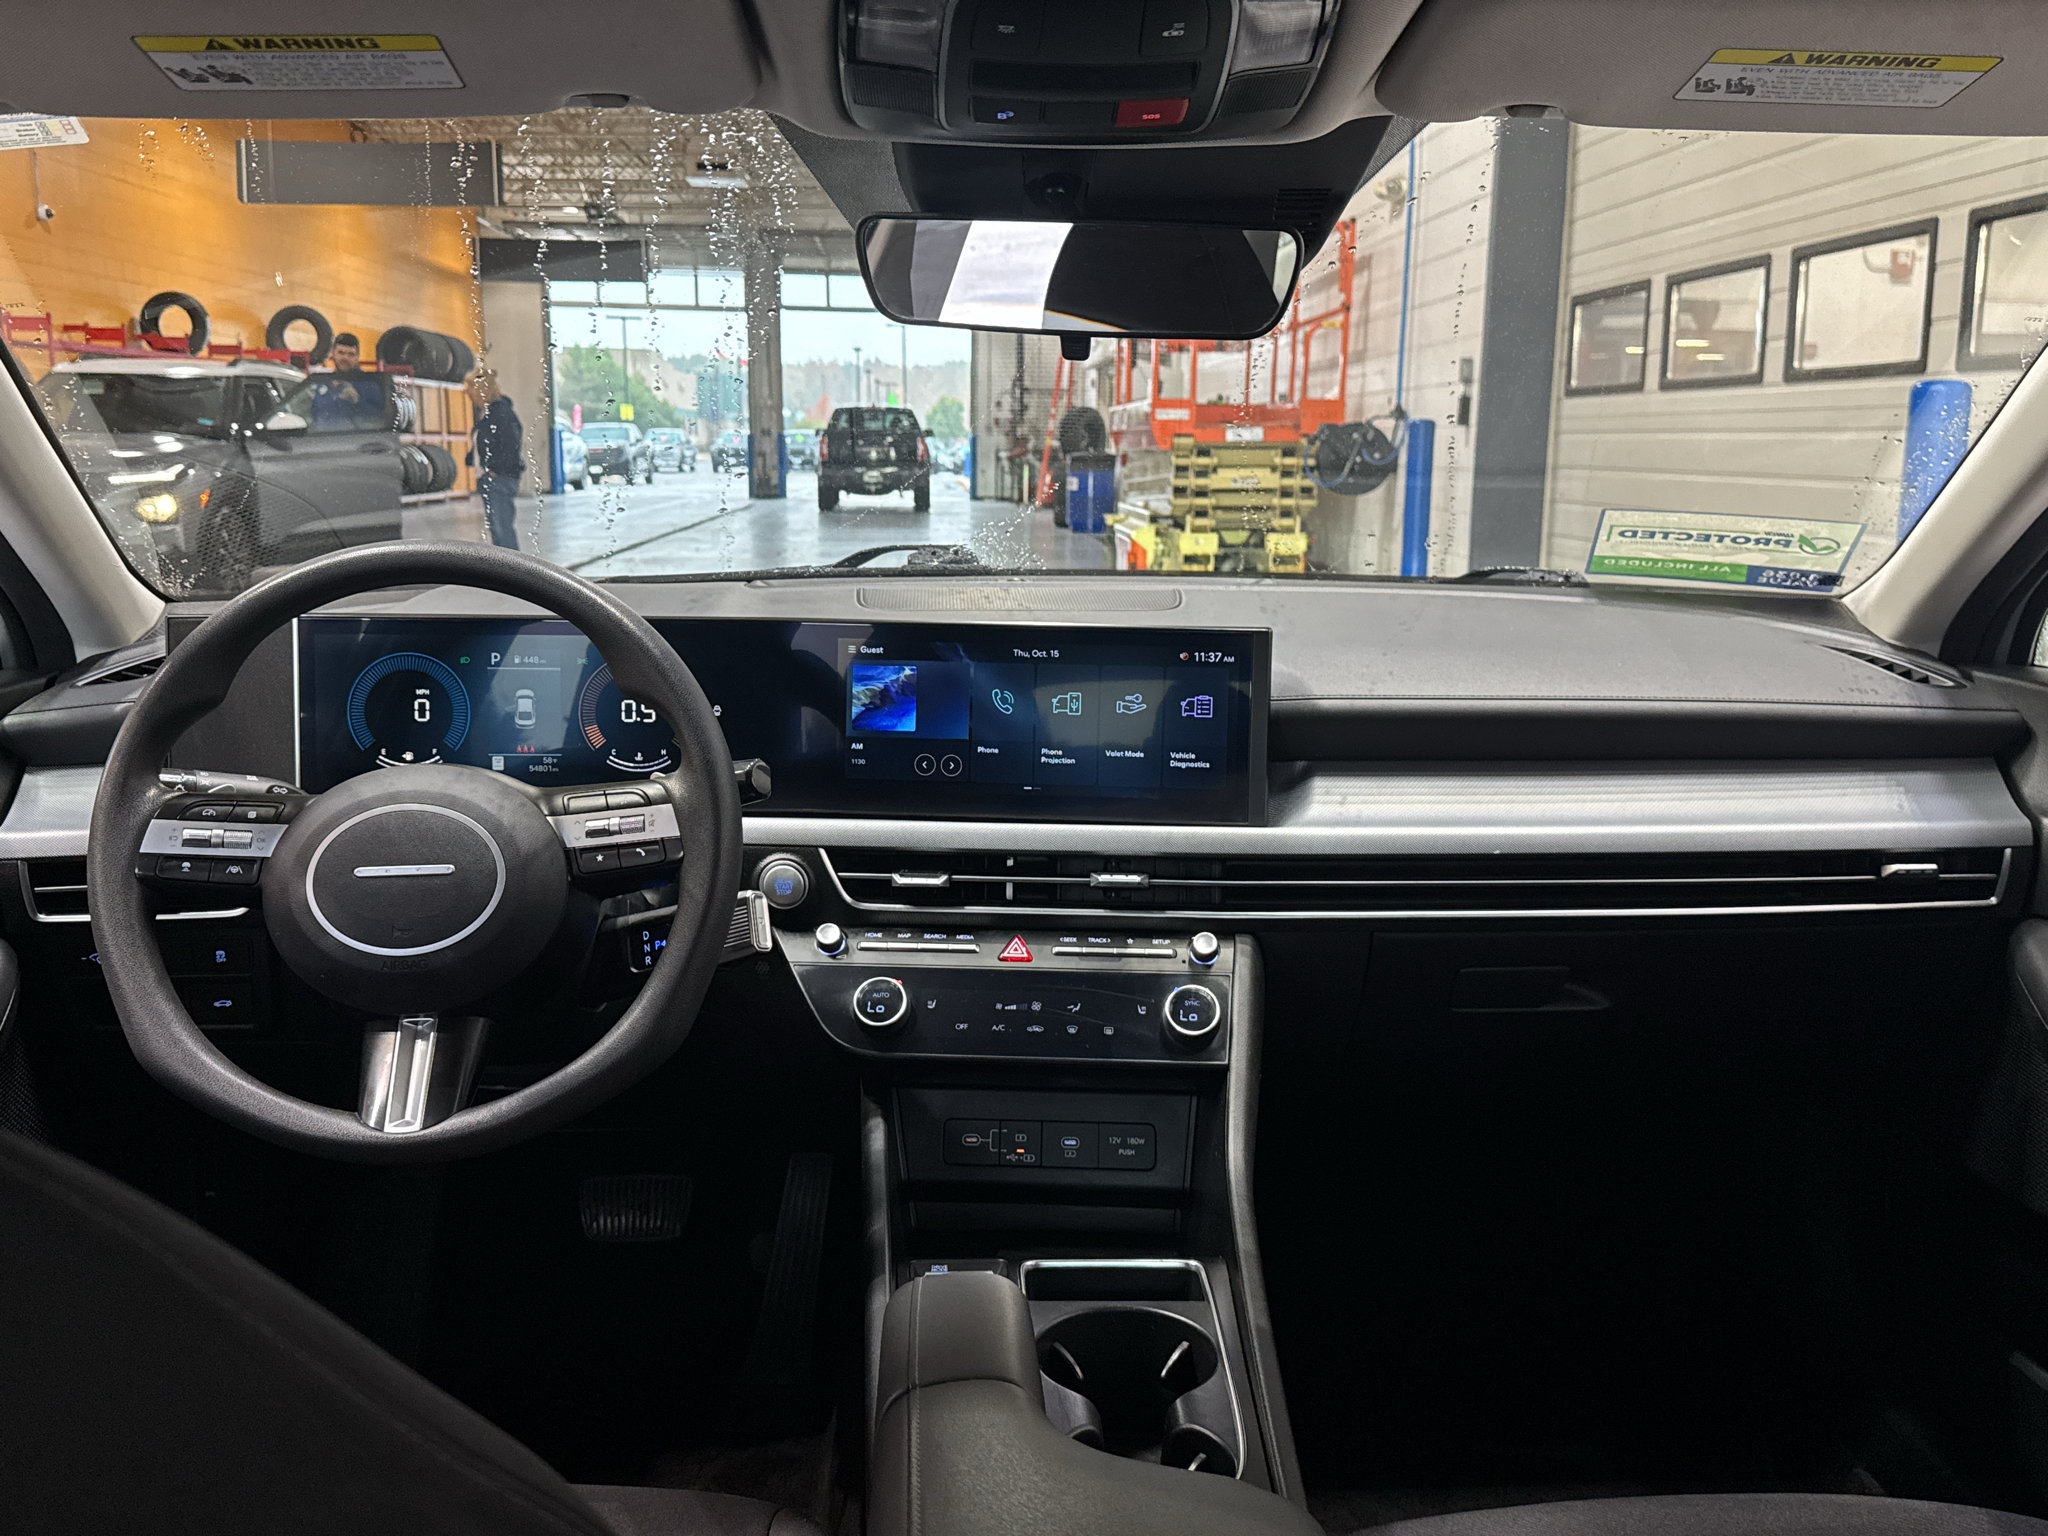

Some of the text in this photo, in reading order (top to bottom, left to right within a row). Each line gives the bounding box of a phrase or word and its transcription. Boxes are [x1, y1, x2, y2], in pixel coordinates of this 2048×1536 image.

[236, 37, 380, 50] WARNING
[1804, 53, 1942, 69] WARNING
[860, 645, 884, 654] Guest
[1013, 649, 1060, 658] Thu, Oct. 15
[491, 652, 501, 666] P
[1194, 652, 1222, 663] 11:37
[415, 688, 430, 696] MPH
[413, 698, 431, 722] 0
[621, 699, 656, 723] 0.5
[851, 742, 864, 750] AM
[977, 746, 999, 754] Phone
[1041, 748, 1063, 756] Phone
[1105, 749, 1145, 758] Valet Mode
[1170, 751, 1196, 759] Vehicle
[1041, 756, 1076, 765] Projection
[1170, 760, 1210, 769] Diagnostics
[643, 931, 649, 941] D
[644, 944, 651, 953] N
[645, 957, 652, 966] R
[866, 1001, 885, 1013] Lo
[1179, 1009, 1198, 1022] Lo
[1118, 1148, 1135, 1156] PUSH
